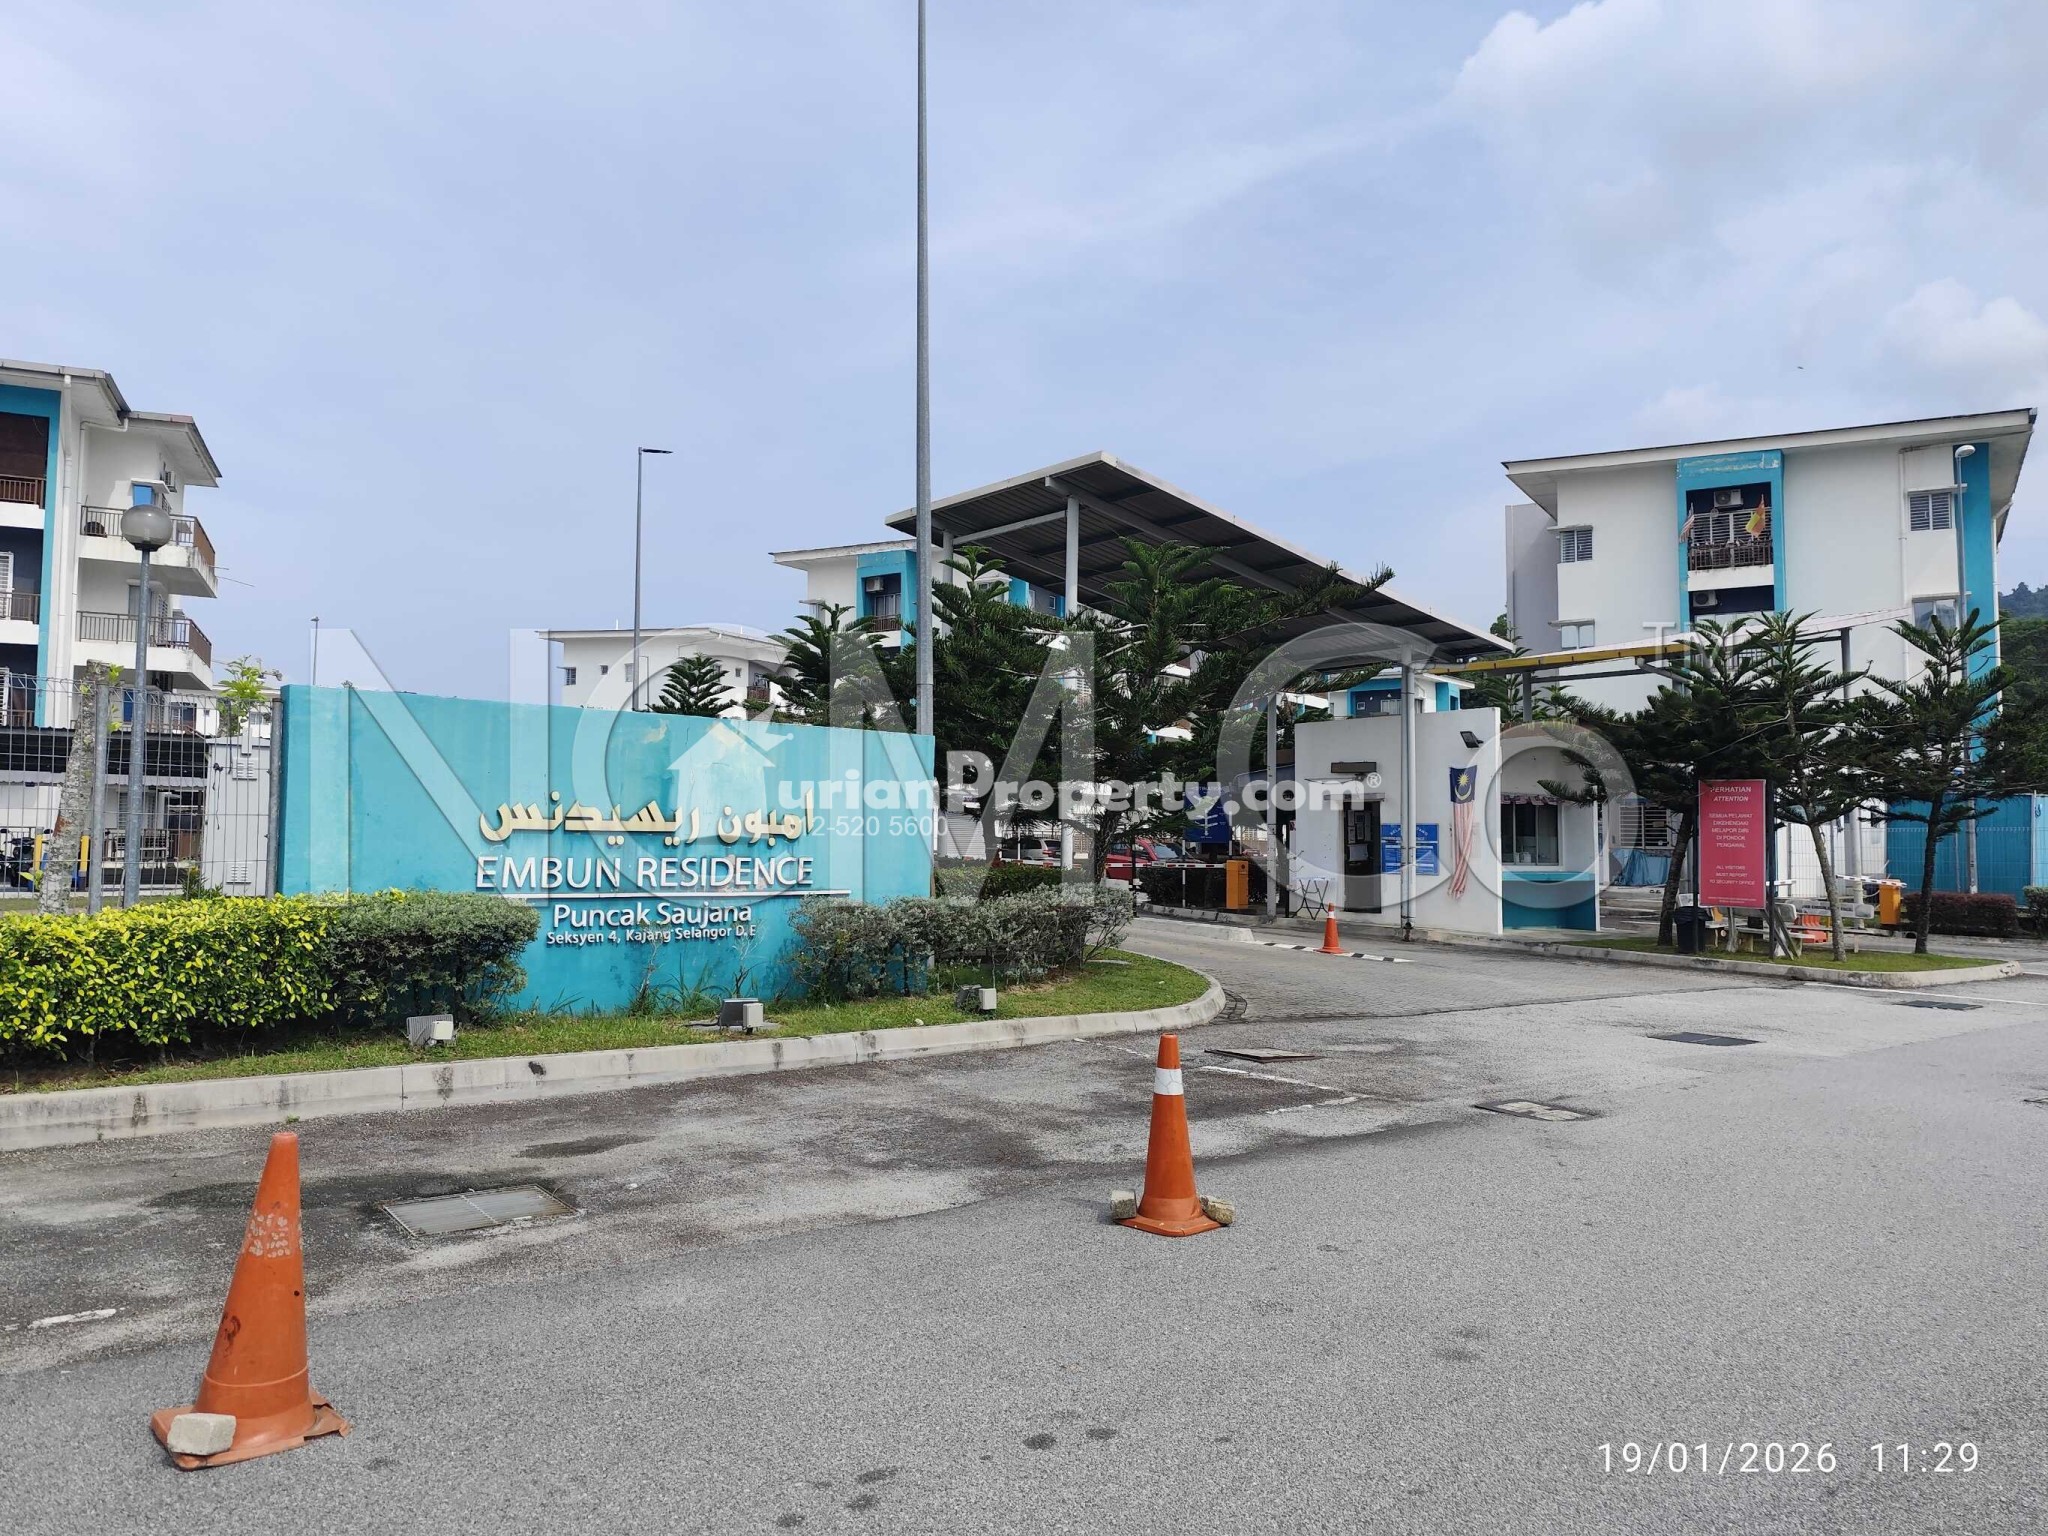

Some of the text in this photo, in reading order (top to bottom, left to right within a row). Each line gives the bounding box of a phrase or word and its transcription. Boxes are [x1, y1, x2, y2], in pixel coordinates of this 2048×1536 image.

[476, 856, 814, 889] EMBUN RESIDENCE
[553, 901, 753, 929] Puncak Saujana
[546, 931, 605, 947] Seksyen
[608, 932, 621, 944] 4,
[626, 929, 672, 943] Kajang
[674, 926, 733, 943] Selangor
